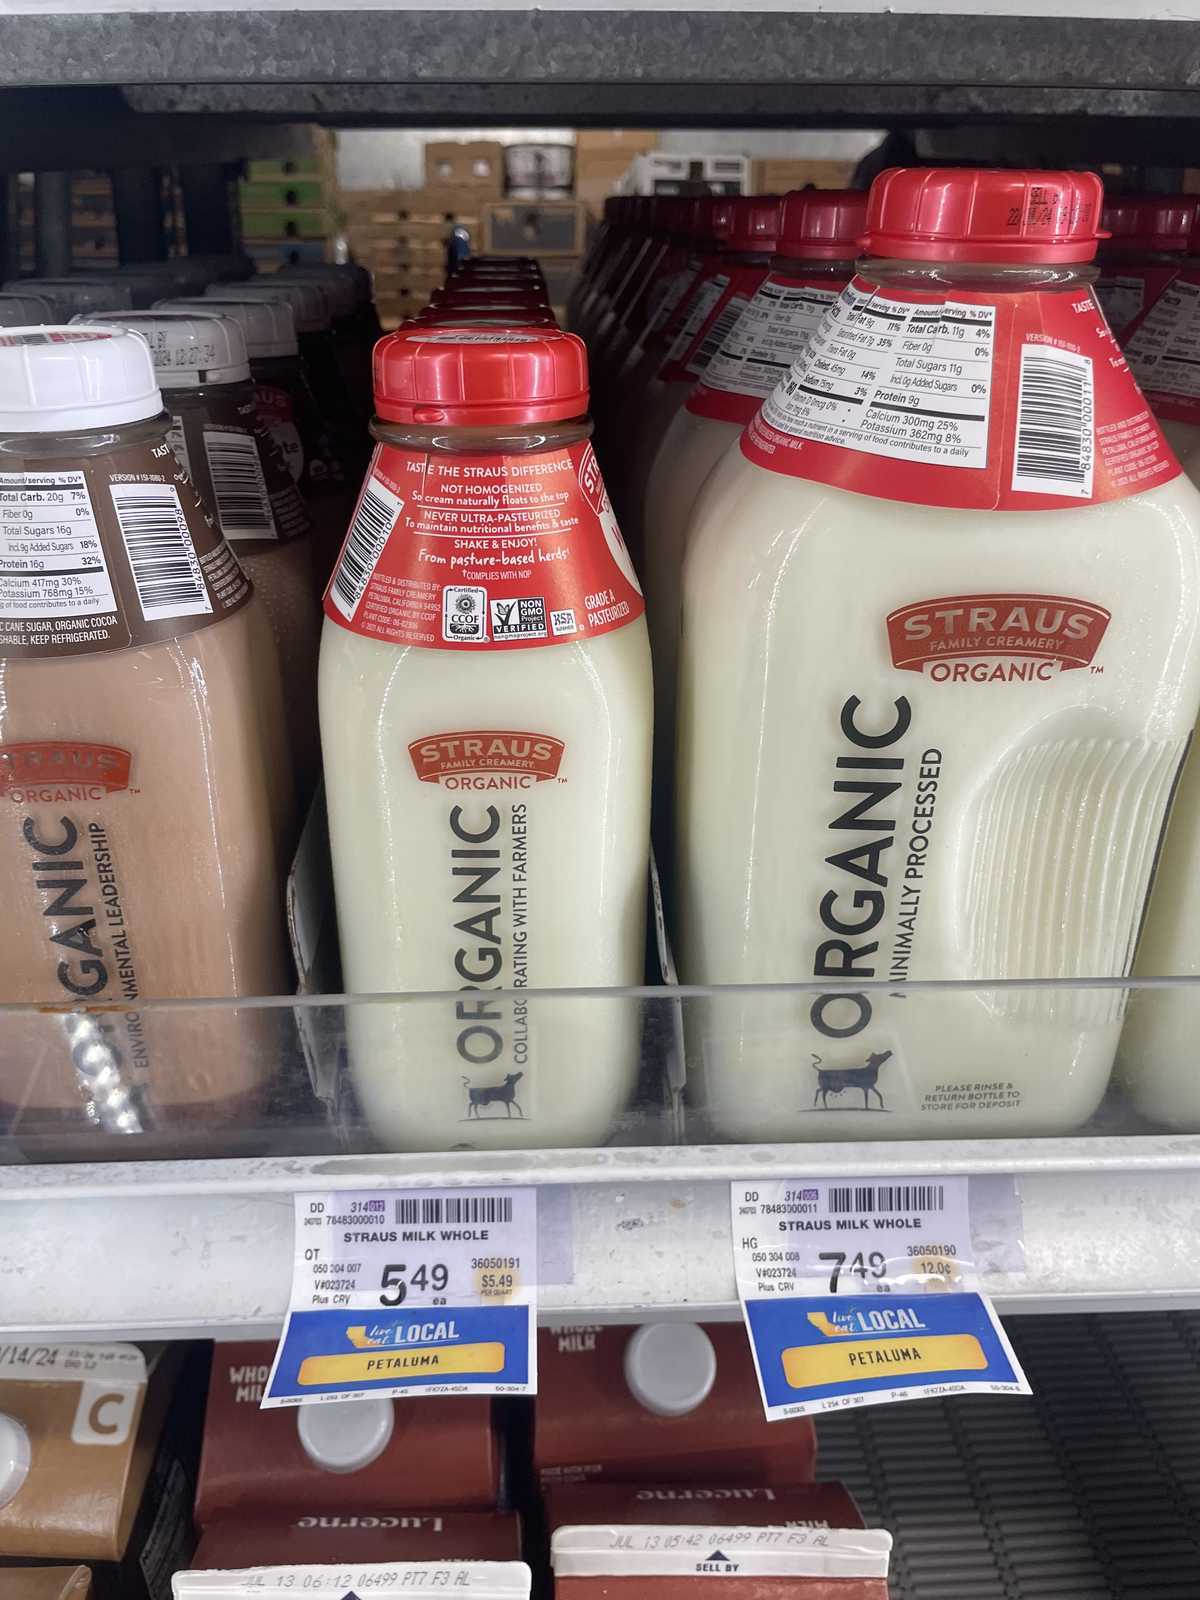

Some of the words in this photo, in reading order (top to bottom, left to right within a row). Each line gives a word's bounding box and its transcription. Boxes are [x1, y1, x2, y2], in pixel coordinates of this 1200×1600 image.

[906, 324, 926, 333] Total
[927, 324, 949, 335] Carb.
[952, 326, 964, 338] 11g
[975, 329, 990, 338] 4%
[902, 341, 920, 350] Fiber
[922, 342, 932, 352] 0g
[974, 348, 989, 357] 0%
[896, 358, 915, 367] Total
[916, 360, 946, 372] Sugars
[949, 364, 963, 375] 11g
[874, 390, 906, 404] Protein
[908, 395, 920, 407] 9g
[865, 409, 901, 423] Calcium
[902, 416, 934, 431] 300mg
[936, 421, 959, 432] 25%
[859, 419, 907, 437] Potassium
[909, 429, 943, 444] 362mg
[945, 434, 962, 444] 8%
[406, 461, 434, 475] TASTE
[438, 466, 460, 477] THE
[463, 466, 508, 478] STRAUS
[511, 458, 574, 477] DIFFERENCE
[441, 484, 464, 494] NOT
[465, 483, 543, 495] HOMOGENIZED
[20, 493, 45, 502] Carb.
[47, 493, 64, 503] 20g
[70, 491, 86, 500] 7%
[412, 490, 422, 501] So
[424, 495, 454, 505] cream
[456, 495, 500, 509] naturally
[502, 494, 529, 507] floats
[529, 495, 538, 504] to
[539, 493, 555, 504] the
[555, 491, 569, 504] top
[3, 509, 21, 518] Fiber
[22, 510, 33, 520] 0g
[75, 508, 89, 516] 0%
[424, 510, 458, 522] NEVER
[460, 509, 561, 524] ULTRA-PASTEURIZED
[3, 526, 21, 535] Total
[23, 526, 55, 537] Sugars
[56, 526, 72, 536] 16g
[405, 517, 415, 528] To
[416, 521, 456, 532] maintain
[458, 521, 512, 534] nutritional
[514, 521, 550, 533] benefits
[552, 520, 559, 530] &
[560, 517, 580, 528] taste
[454, 539, 488, 549] SHAKE
[491, 539, 500, 549] &
[501, 538, 538, 549] ENJOY!
[418, 548, 447, 564] From
[450, 551, 535, 569] pasture-based
[453, 586, 479, 594] Certified
[520, 600, 542, 609] NON
[584, 591, 610, 611] GRADE
[609, 589, 616, 602] A
[451, 614, 480, 624] CCOF
[520, 607, 543, 617] GMO
[521, 615, 544, 623] Project
[587, 600, 630, 628] PASTEURIZED
[5, 622, 25, 632] CANE
[26, 621, 54, 633] SUGAR,
[55, 618, 90, 631] ORGANIC
[90, 616, 118, 628] COCOA
[496, 623, 545, 633] VERIFIED
[903, 607, 1095, 641] STRAUS
[30, 634, 50, 645] KEEP
[52, 629, 111, 644] REFRIGERATED.
[453, 633, 476, 642] Organic
[930, 636, 979, 651] FAMILY
[986, 636, 1064, 650] CREAMERY
[930, 662, 1053, 682] ORGANIC
[419, 738, 553, 763] STRAUS
[440, 758, 475, 770] FAMILY
[479, 757, 535, 769] CREAMERY
[444, 776, 532, 790] ORGANIC
[11, 786, 102, 804] ORGANIC
[904, 747, 943, 879] PROCESSED
[511, 803, 528, 884] FARMERS
[811, 694, 912, 1038] ORGANIC
[88, 822, 125, 926] LEADERSHIP
[511, 886, 528, 928] WITH
[935, 1083, 972, 1092] PLEASE
[973, 1082, 1003, 1091] RINSE
[924, 1093, 966, 1102] RETURN
[968, 1092, 1004, 1101] BOTTLE
[1007, 1090, 1020, 1099] TO
[921, 1103, 953, 1112] STORE
[955, 1101, 977, 1110] FOR
[978, 1100, 1021, 1109] DEPOSIT
[745, 1191, 759, 1202] DD
[310, 1203, 325, 1213] DD
[778, 1221, 832, 1231] STRAUS
[836, 1219, 869, 1230] MILK
[874, 1218, 922, 1229] WHOLE
[343, 1232, 398, 1243] STRAUS
[402, 1231, 436, 1242] MILK
[440, 1230, 489, 1241] WHOLE
[742, 1237, 758, 1249] HG
[906, 1244, 957, 1257] 36050190
[471, 1257, 520, 1270] 36050191
[314, 1280, 355, 1290] V#023724
[481, 1274, 513, 1288] $5.49
[876, 1284, 891, 1293] ea
[432, 1297, 447, 1306] ea
[856, 1308, 926, 1331] LOCAL
[394, 1320, 460, 1344] LOCAL
[558, 1333, 596, 1353] MILK
[367, 1354, 439, 1371] PETALUMA
[848, 1347, 922, 1366] PETALUMA
[89, 1392, 125, 1435] C
[635, 1487, 776, 1501] Lucerne
[297, 1515, 443, 1532] Lucerne
[645, 1535, 661, 1549] 13
[708, 1532, 752, 1545] 06499
[787, 1532, 807, 1544] F3
[812, 1535, 829, 1547] AL
[695, 1563, 720, 1572] SELL
[725, 1563, 740, 1572] BY
[277, 1575, 296, 1587] 13
[303, 1574, 352, 1588] 06:12
[357, 1572, 398, 1587] 06499
[431, 1572, 448, 1586] F3
[454, 1571, 471, 1585] AL
